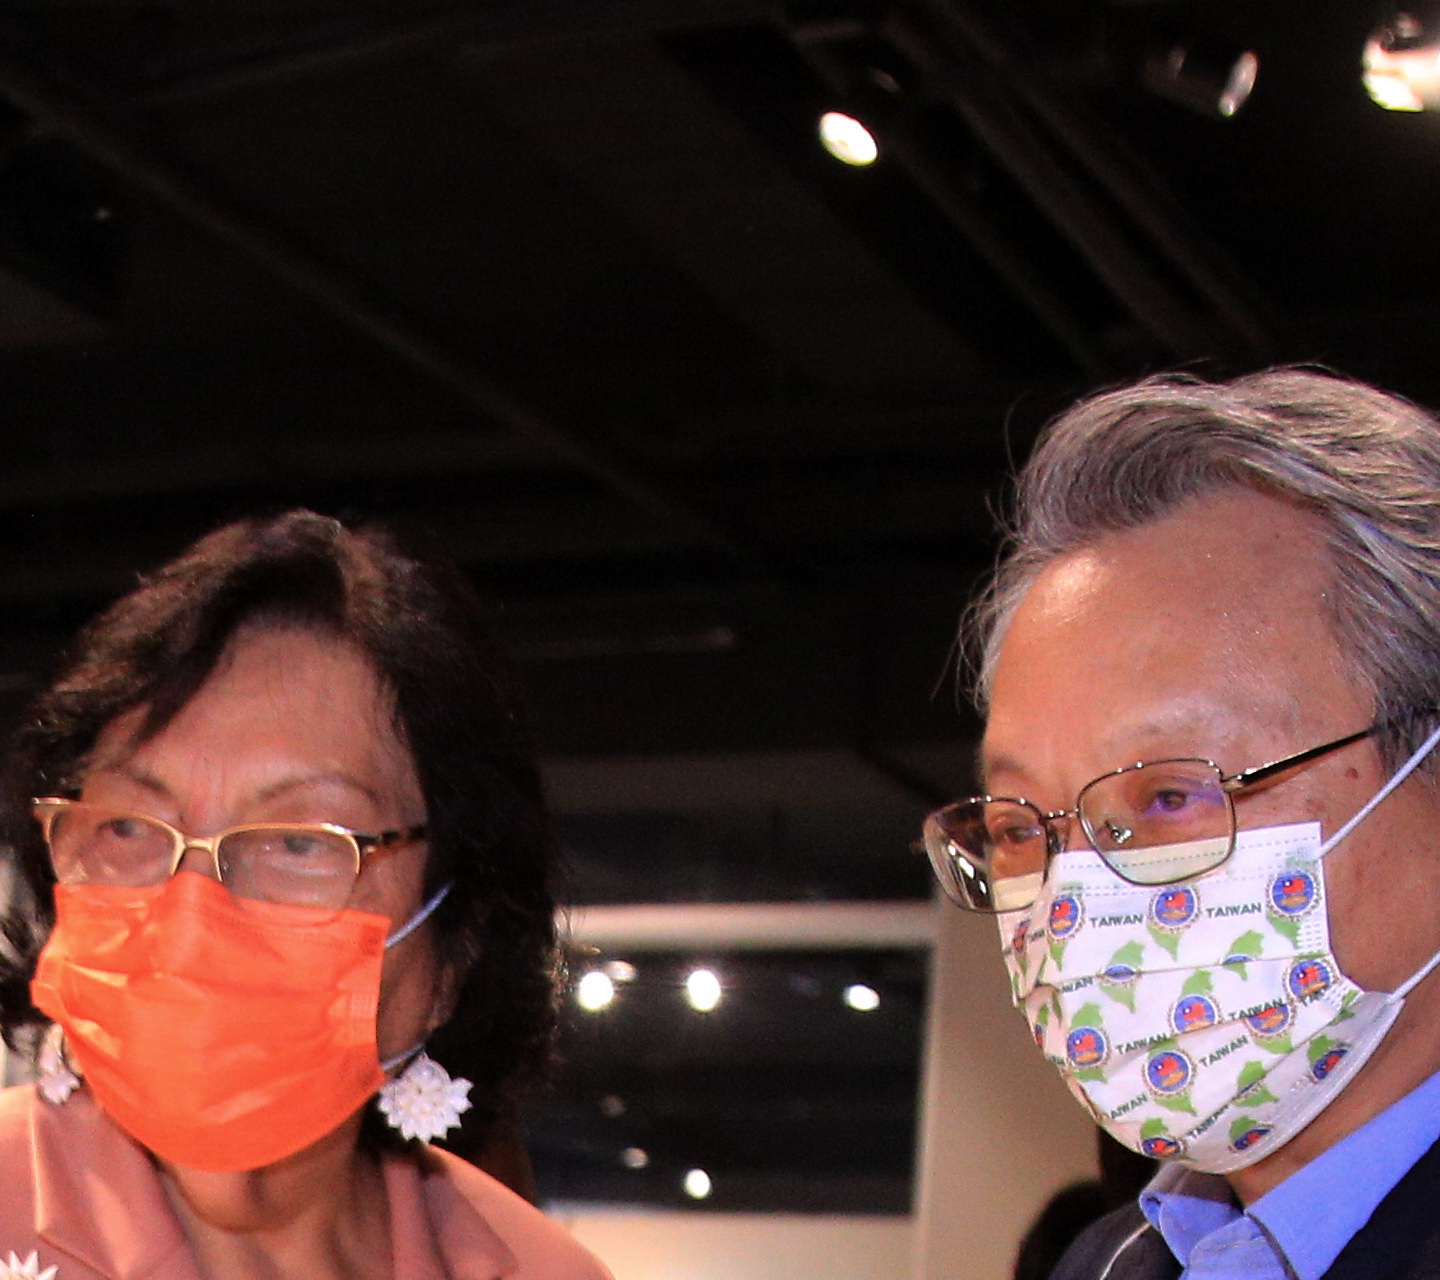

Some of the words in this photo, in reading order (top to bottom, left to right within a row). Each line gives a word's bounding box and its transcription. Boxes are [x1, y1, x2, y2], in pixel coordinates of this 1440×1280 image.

[1090, 913, 1144, 929] TAIWAN
[1206, 902, 1263, 919] TAIWAN
[1116, 1032, 1169, 1055] TAIWAN
[1199, 1034, 1249, 1067] TAIWAN
[1103, 1093, 1149, 1119] AIWAN
